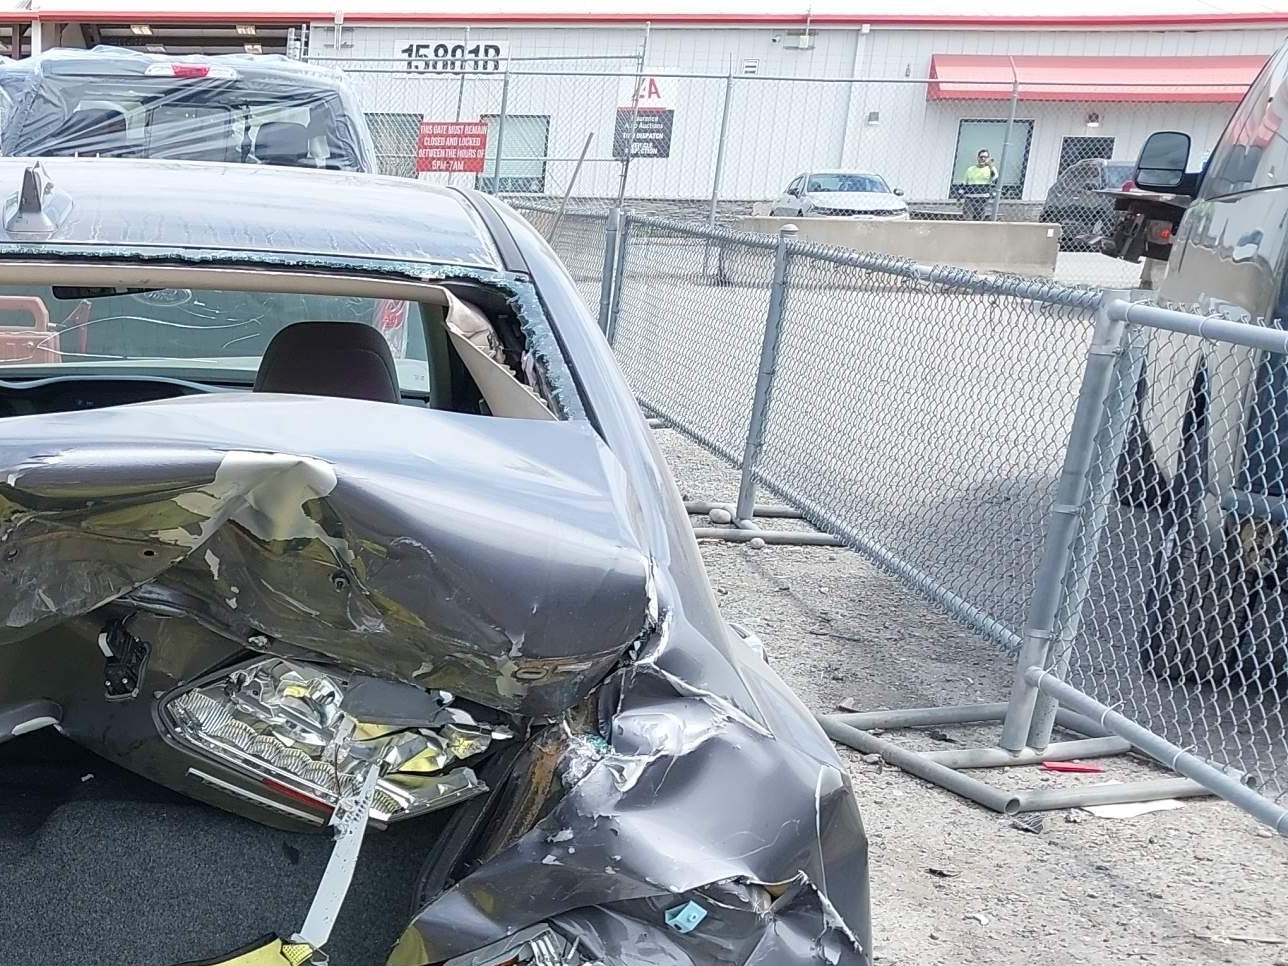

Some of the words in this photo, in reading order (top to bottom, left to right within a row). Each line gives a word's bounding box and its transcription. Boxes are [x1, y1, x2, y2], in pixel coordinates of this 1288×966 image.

[434, 125, 447, 134] GATE
[448, 125, 464, 134] MUST
[465, 125, 487, 134] REMAIN
[424, 137, 446, 146] CLOSED
[446, 137, 458, 146] AND
[459, 137, 481, 146] LOCKED
[418, 149, 446, 158] BETWEEN
[446, 149, 457, 158] THE
[457, 149, 477, 158] HOURS
[477, 149, 485, 158] OF
